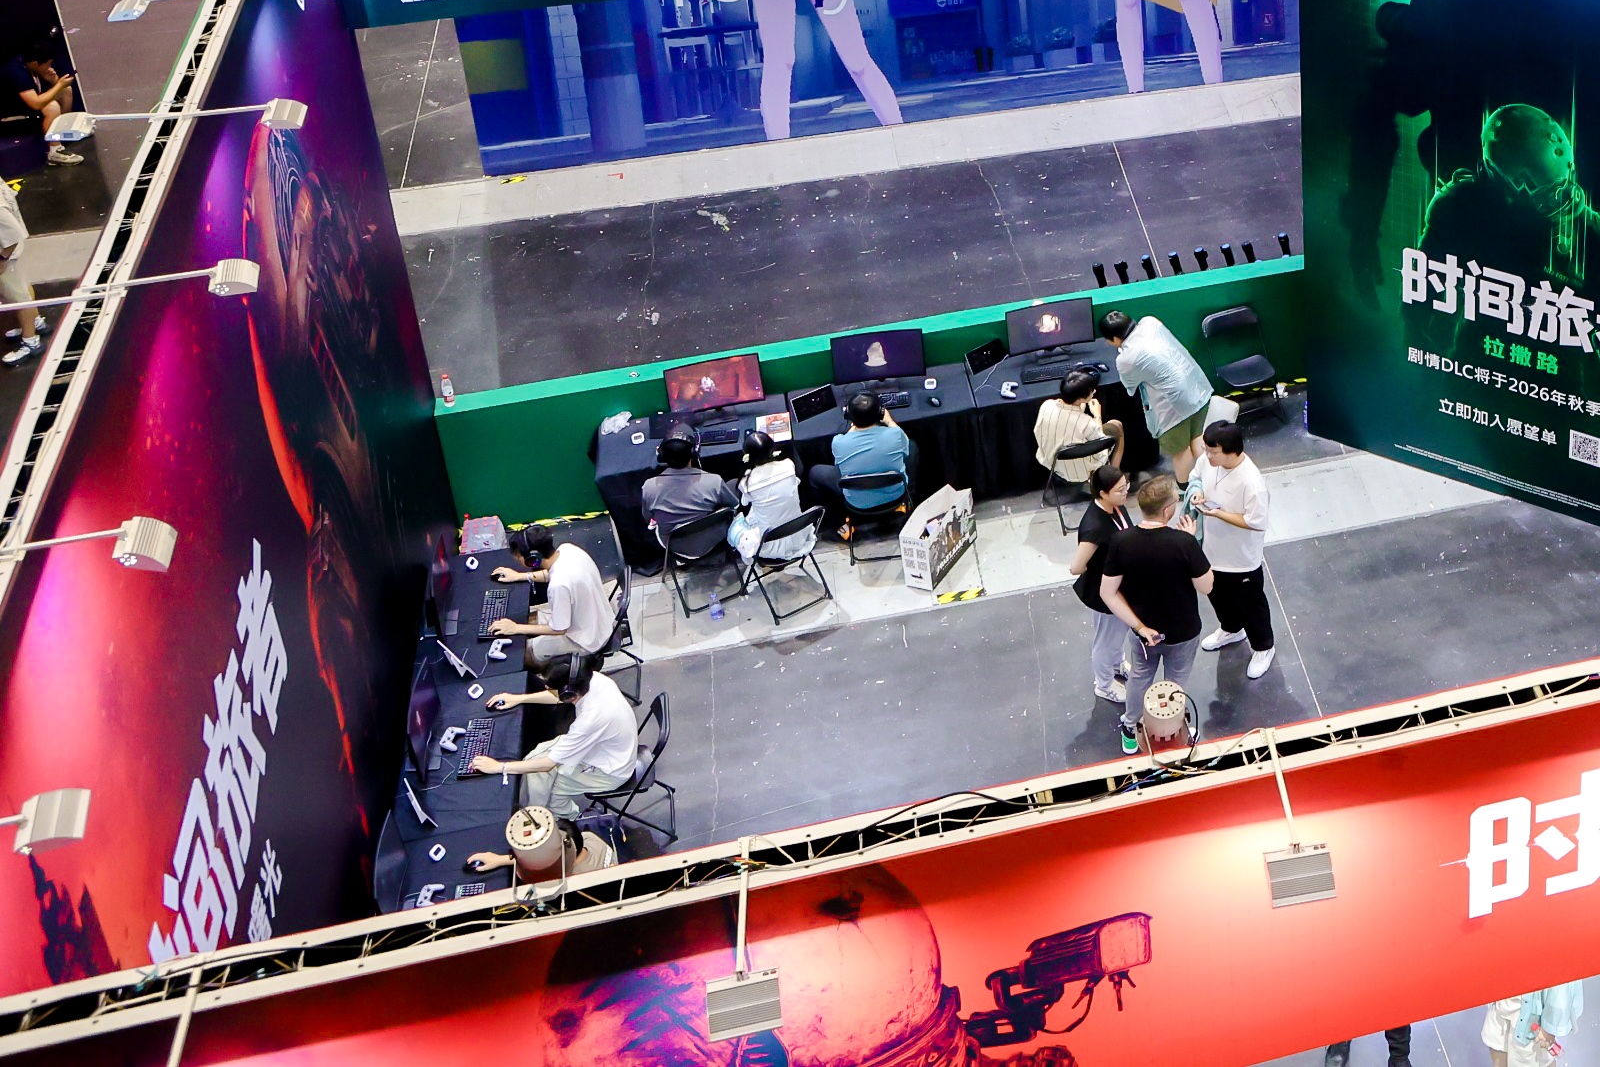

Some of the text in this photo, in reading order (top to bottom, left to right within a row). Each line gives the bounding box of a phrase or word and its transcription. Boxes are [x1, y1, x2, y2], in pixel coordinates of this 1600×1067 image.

[1483, 335, 1559, 376] 拉撒路
[1437, 397, 1558, 447] 立即加入愿望单
[148, 537, 288, 964] 间旅者
